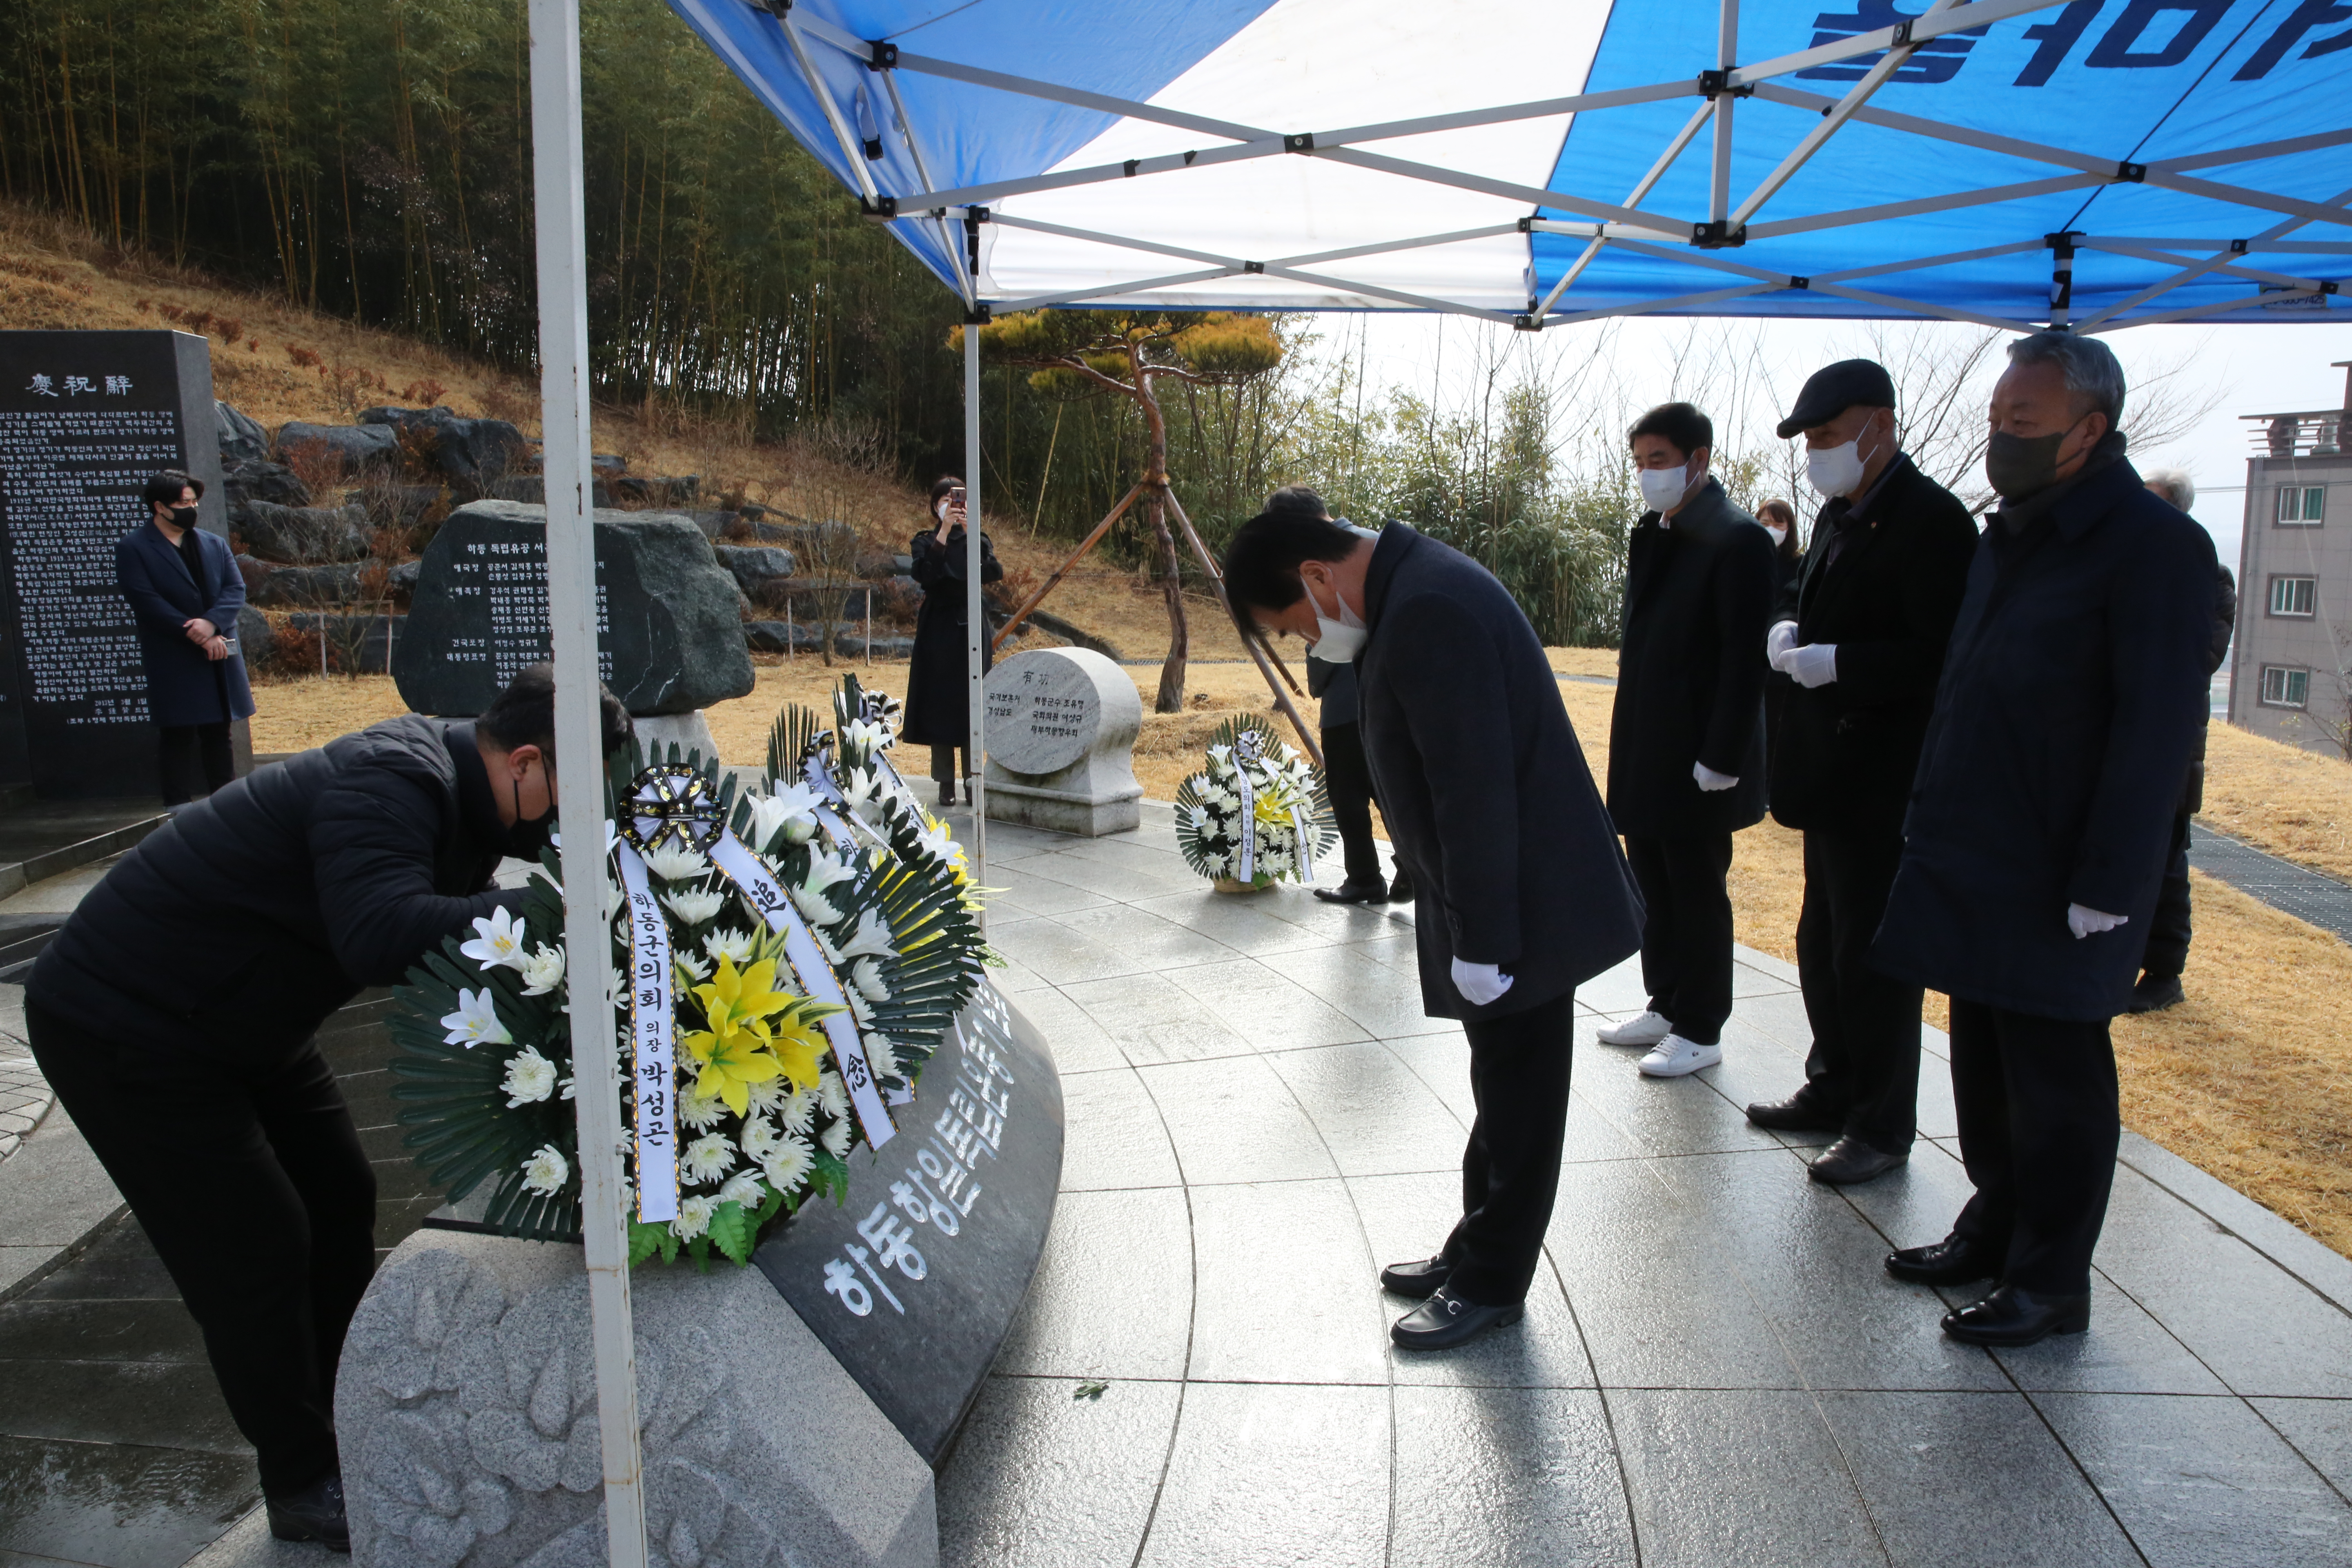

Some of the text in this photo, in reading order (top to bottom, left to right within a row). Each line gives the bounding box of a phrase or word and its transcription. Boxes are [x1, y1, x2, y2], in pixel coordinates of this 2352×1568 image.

[468, 544, 486, 554] 하동
[491, 543, 529, 553] 독립유공
[989, 693, 1020, 705] 국가보훈처
[1035, 696, 1061, 707] 하동군수
[988, 707, 1012, 716] 경상남도
[1033, 711, 1058, 721] 국회의원
[631, 892, 670, 1147] 하동군의회 의장 박성곤
